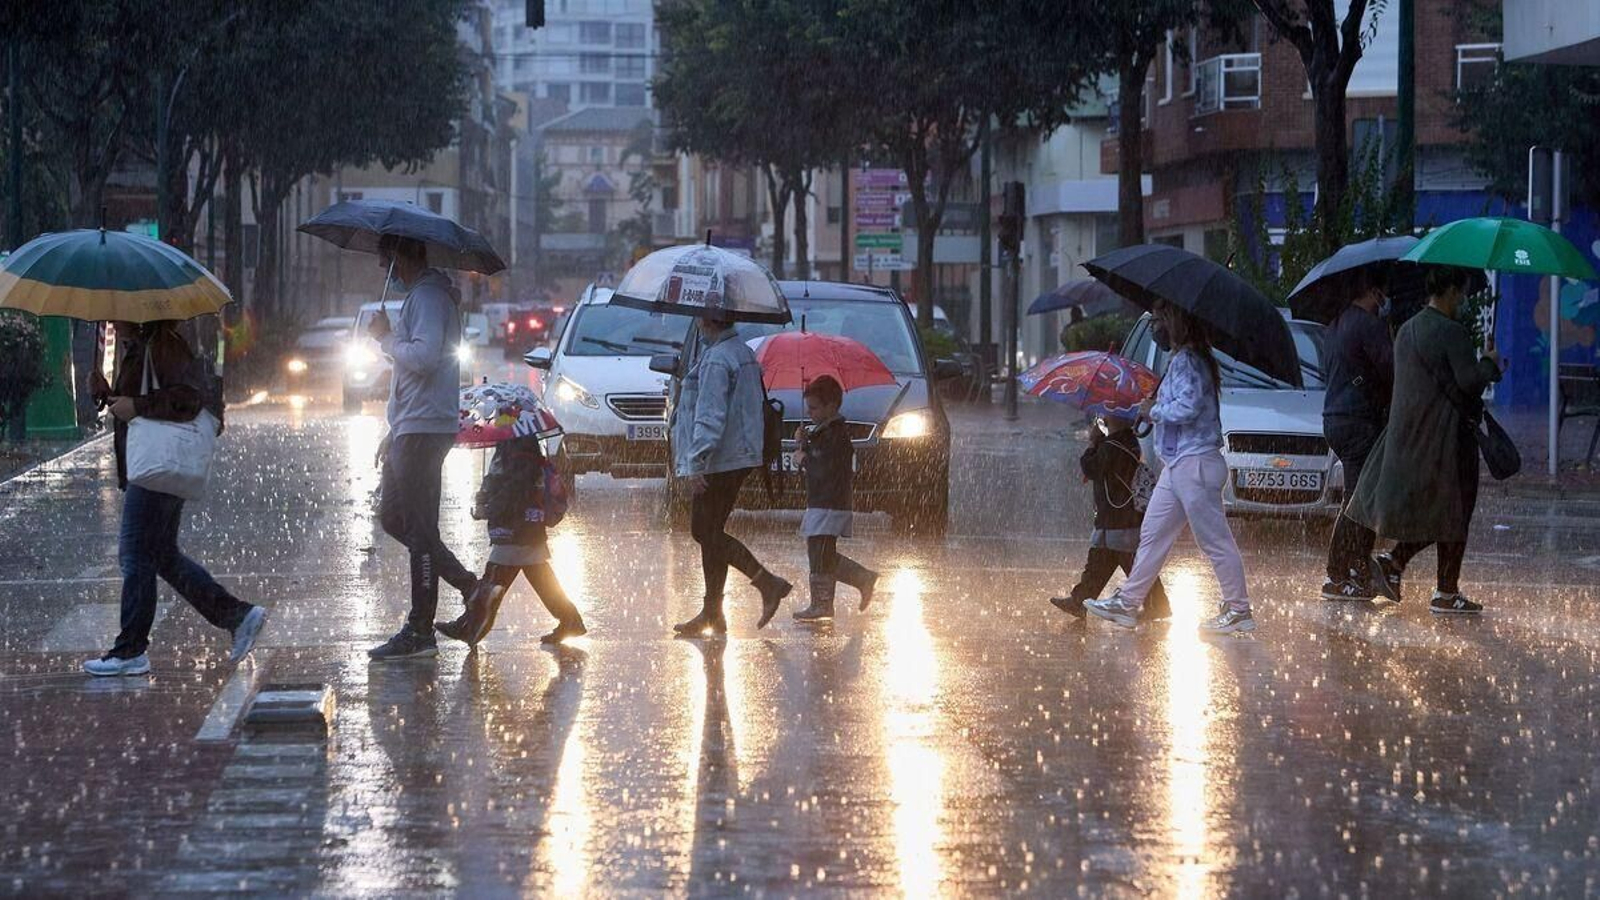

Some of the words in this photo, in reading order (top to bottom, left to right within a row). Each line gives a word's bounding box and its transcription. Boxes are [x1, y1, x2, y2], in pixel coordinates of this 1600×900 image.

[1248, 472, 1285, 487] 2753
[1290, 473, 1318, 488] GSS
[1452, 599, 1466, 609] N
